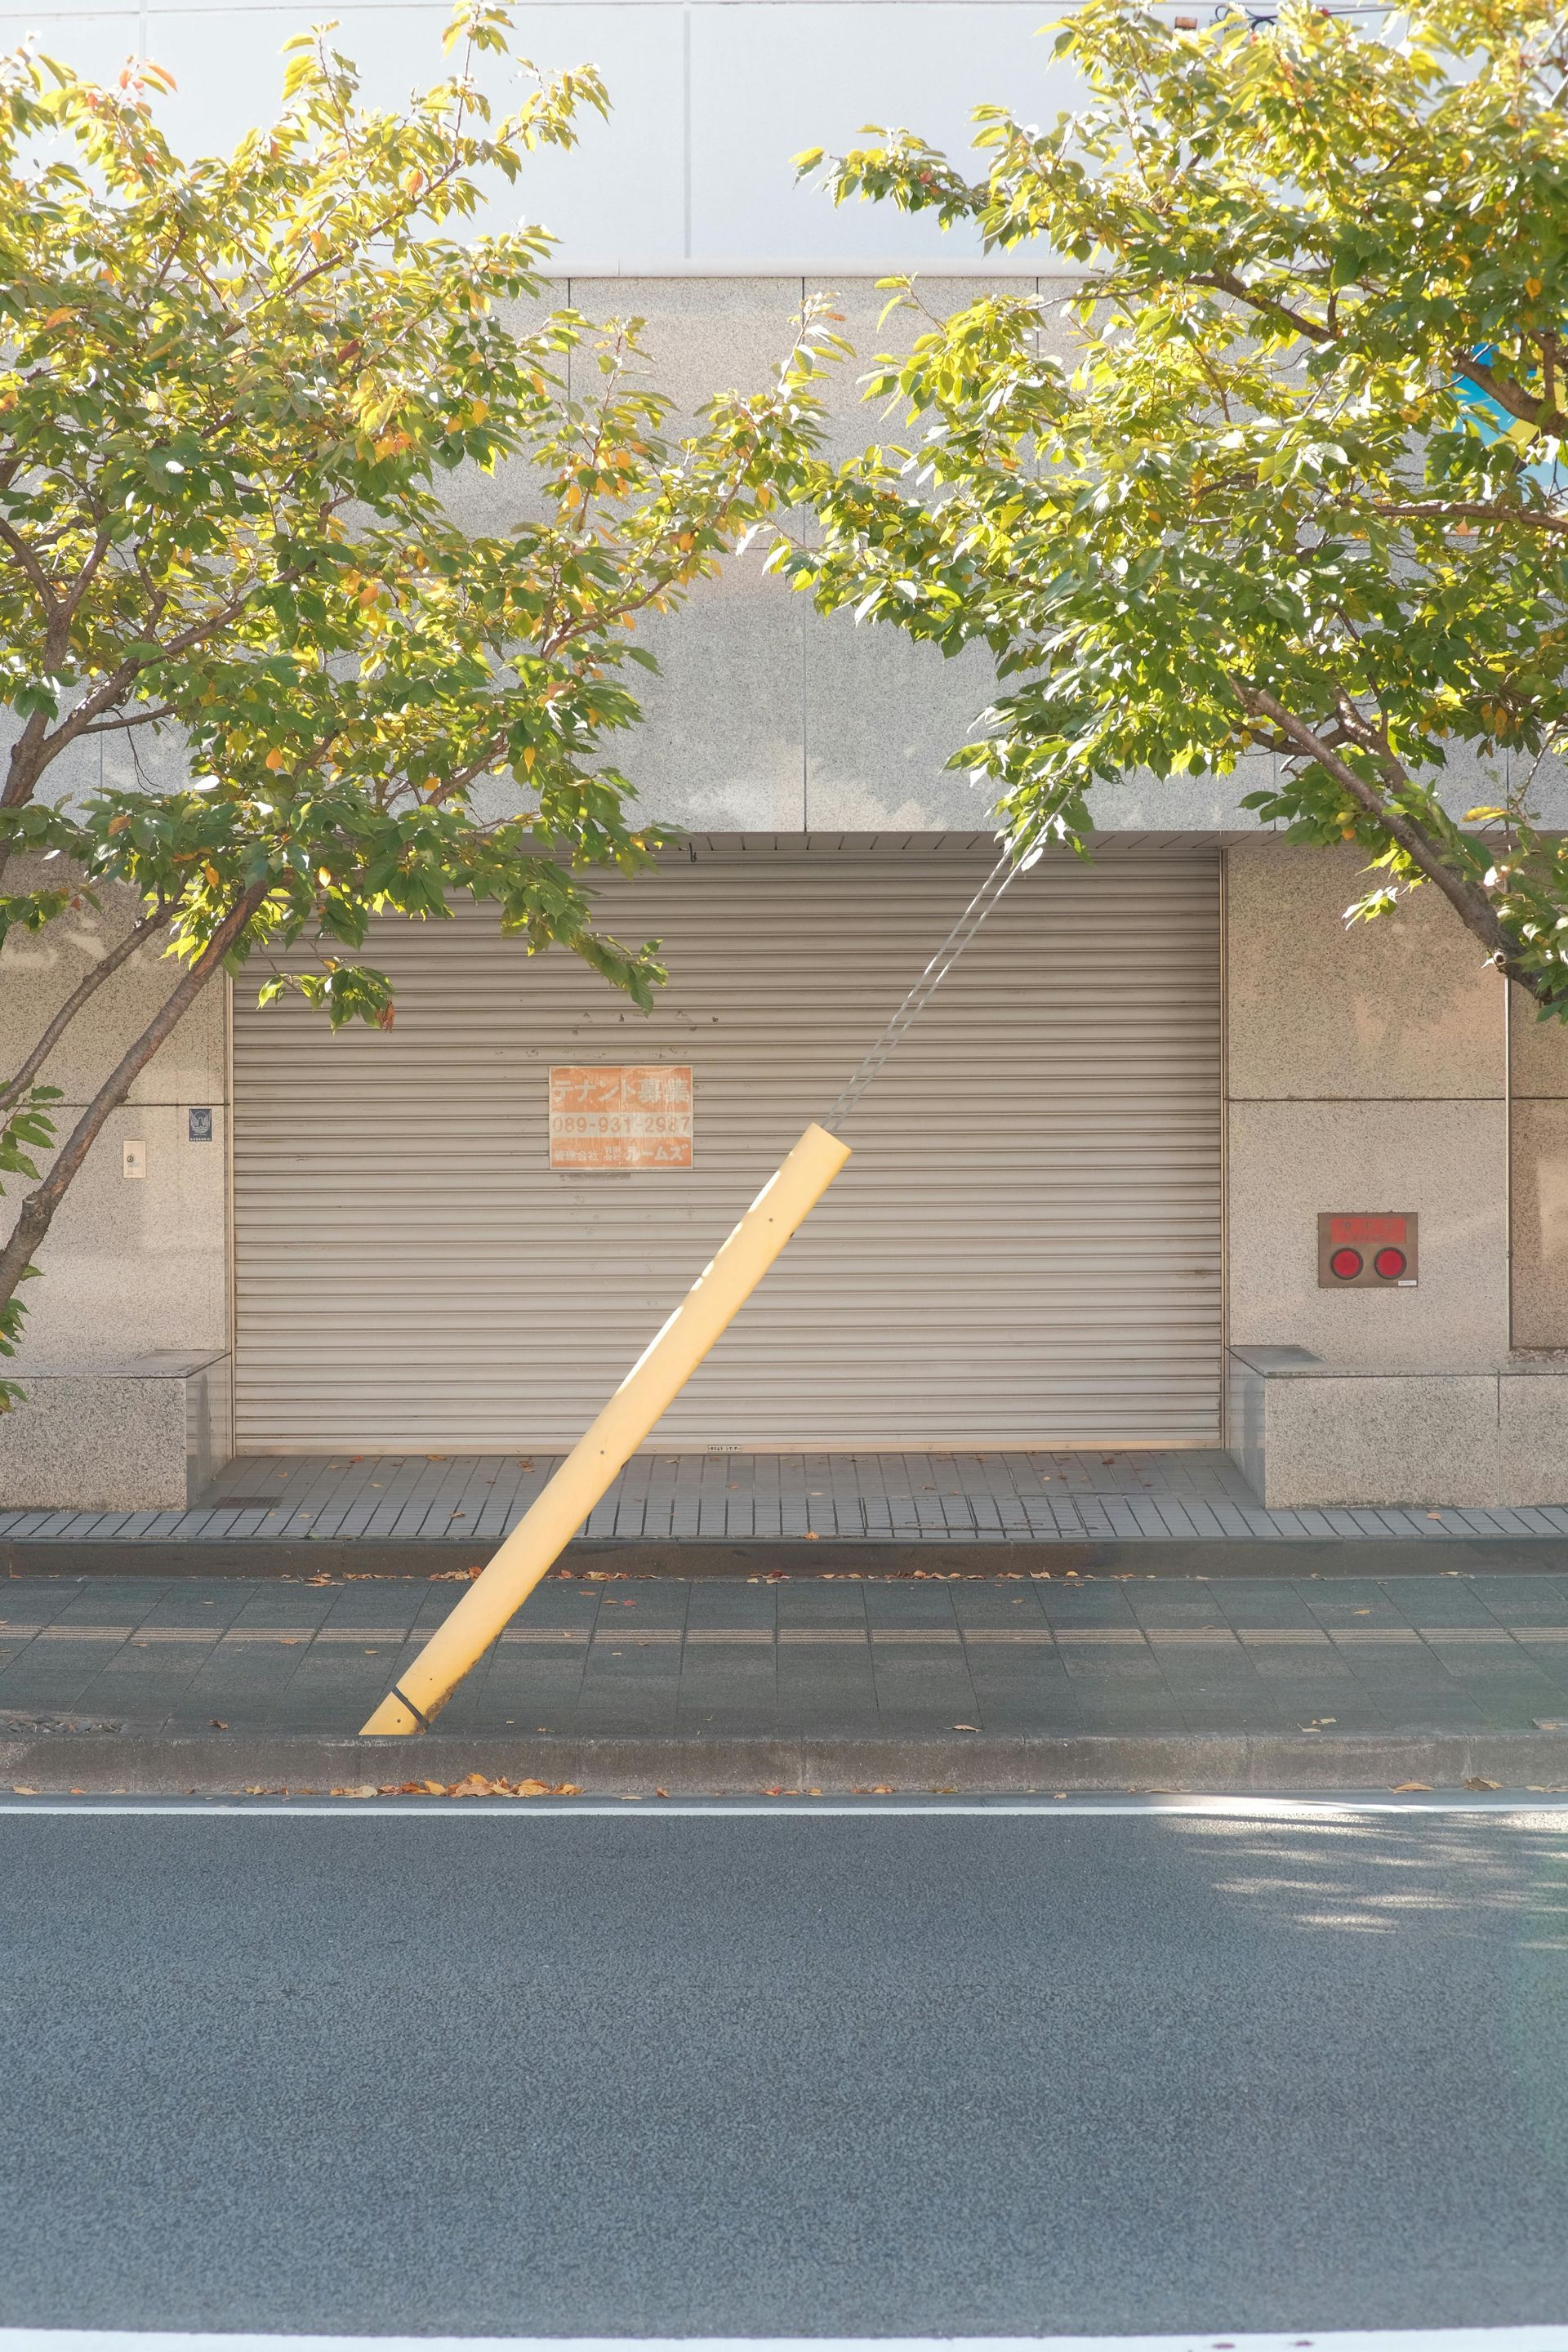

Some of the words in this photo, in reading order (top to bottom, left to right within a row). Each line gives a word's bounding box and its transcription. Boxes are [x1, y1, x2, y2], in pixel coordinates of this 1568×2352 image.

[552, 1077, 689, 1103] テナント募集
